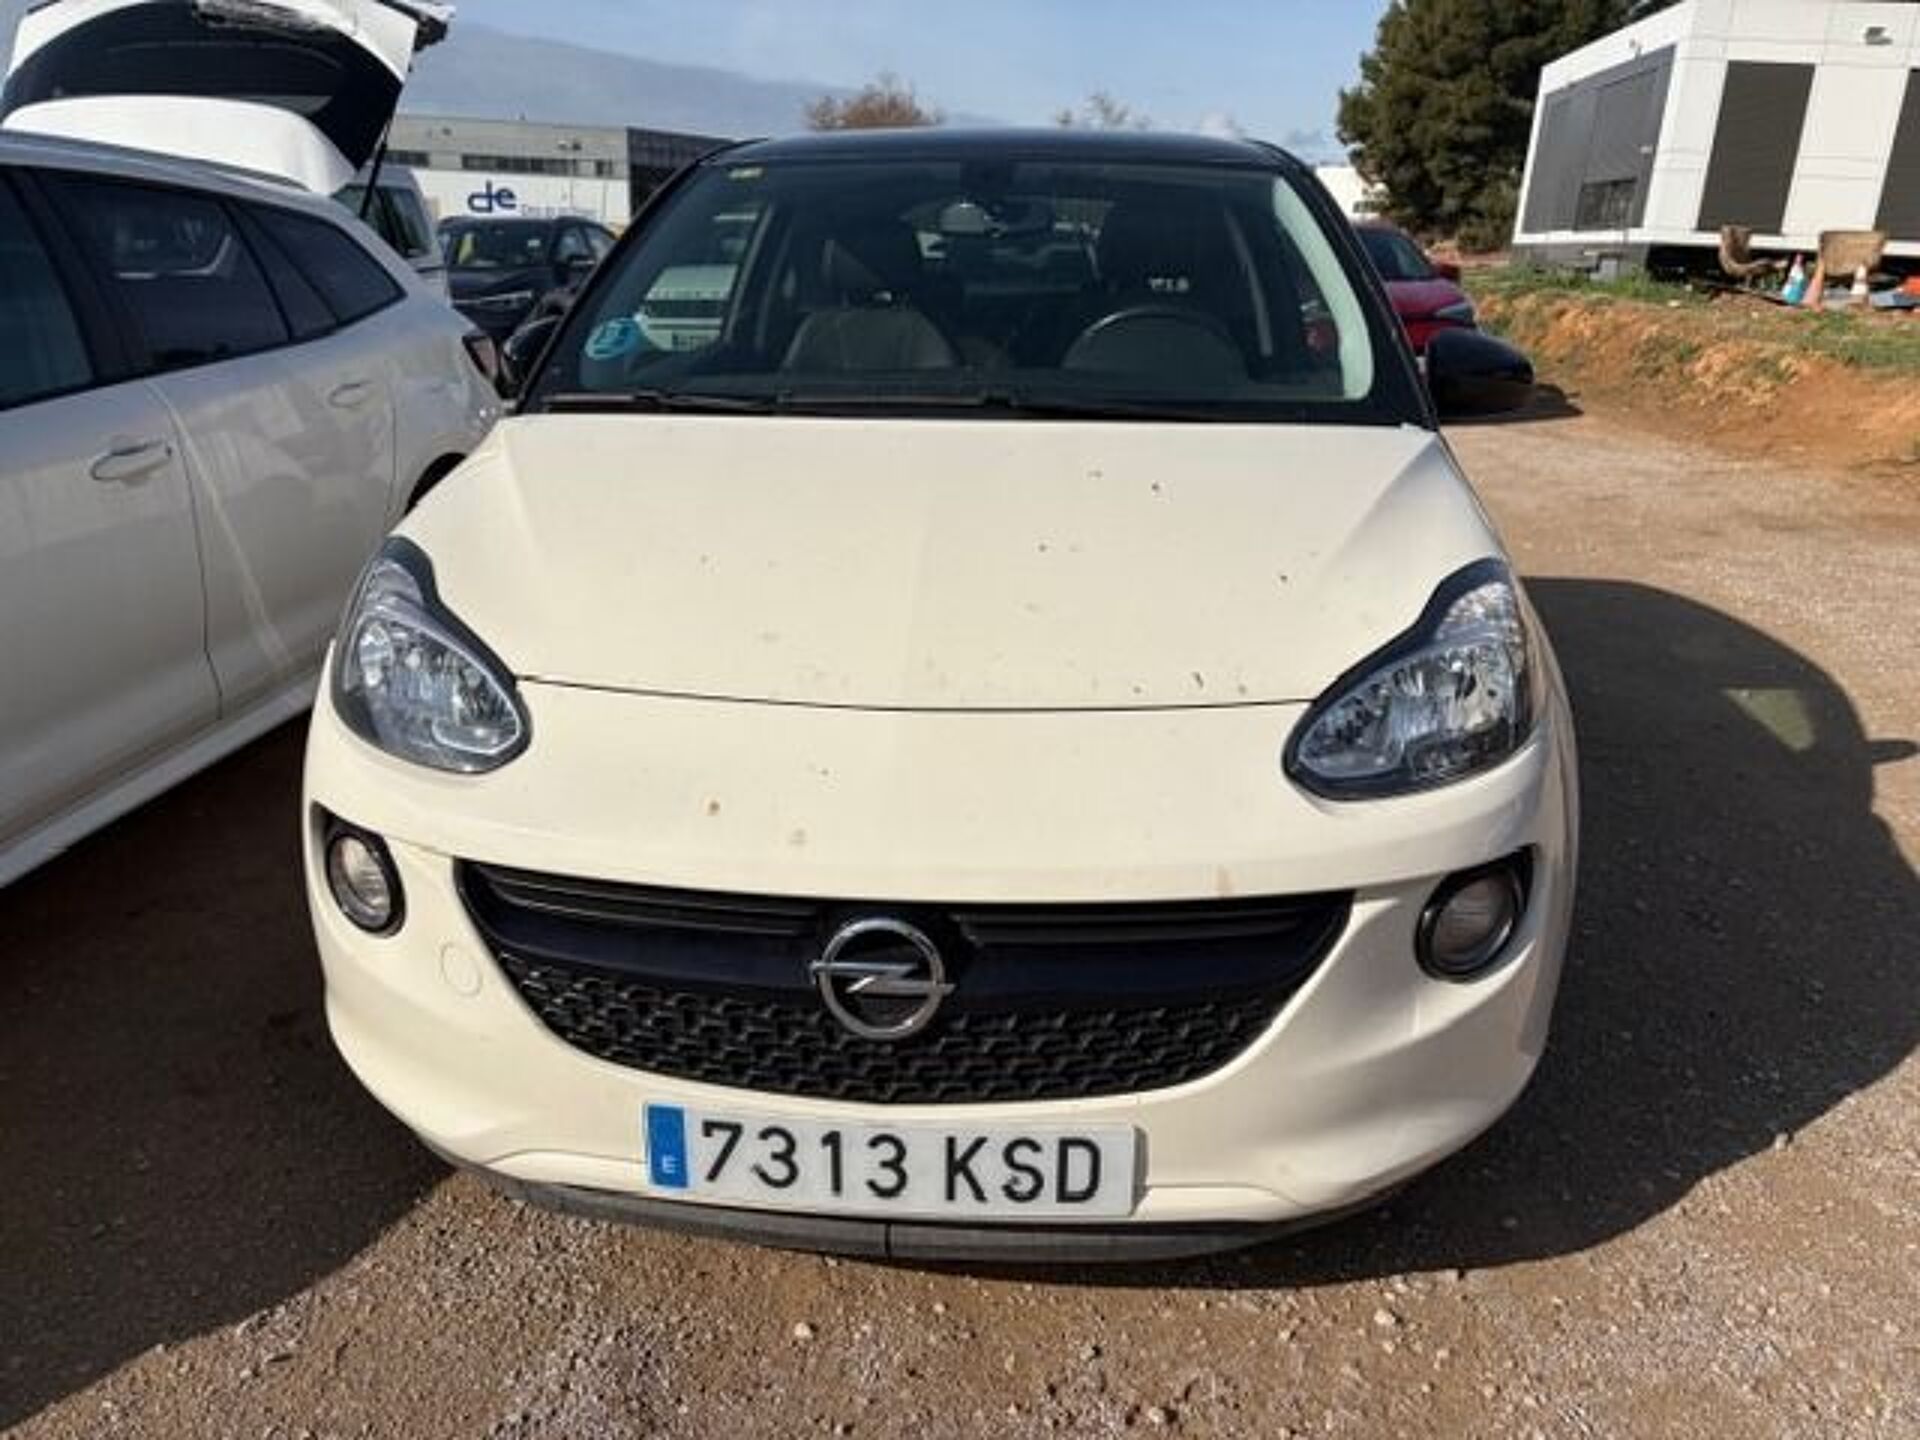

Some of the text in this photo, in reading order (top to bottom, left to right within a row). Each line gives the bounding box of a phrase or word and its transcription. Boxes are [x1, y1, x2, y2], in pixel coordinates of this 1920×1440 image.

[467, 180, 517, 213] de
[661, 1120, 1100, 1204] E 7313 KSD
